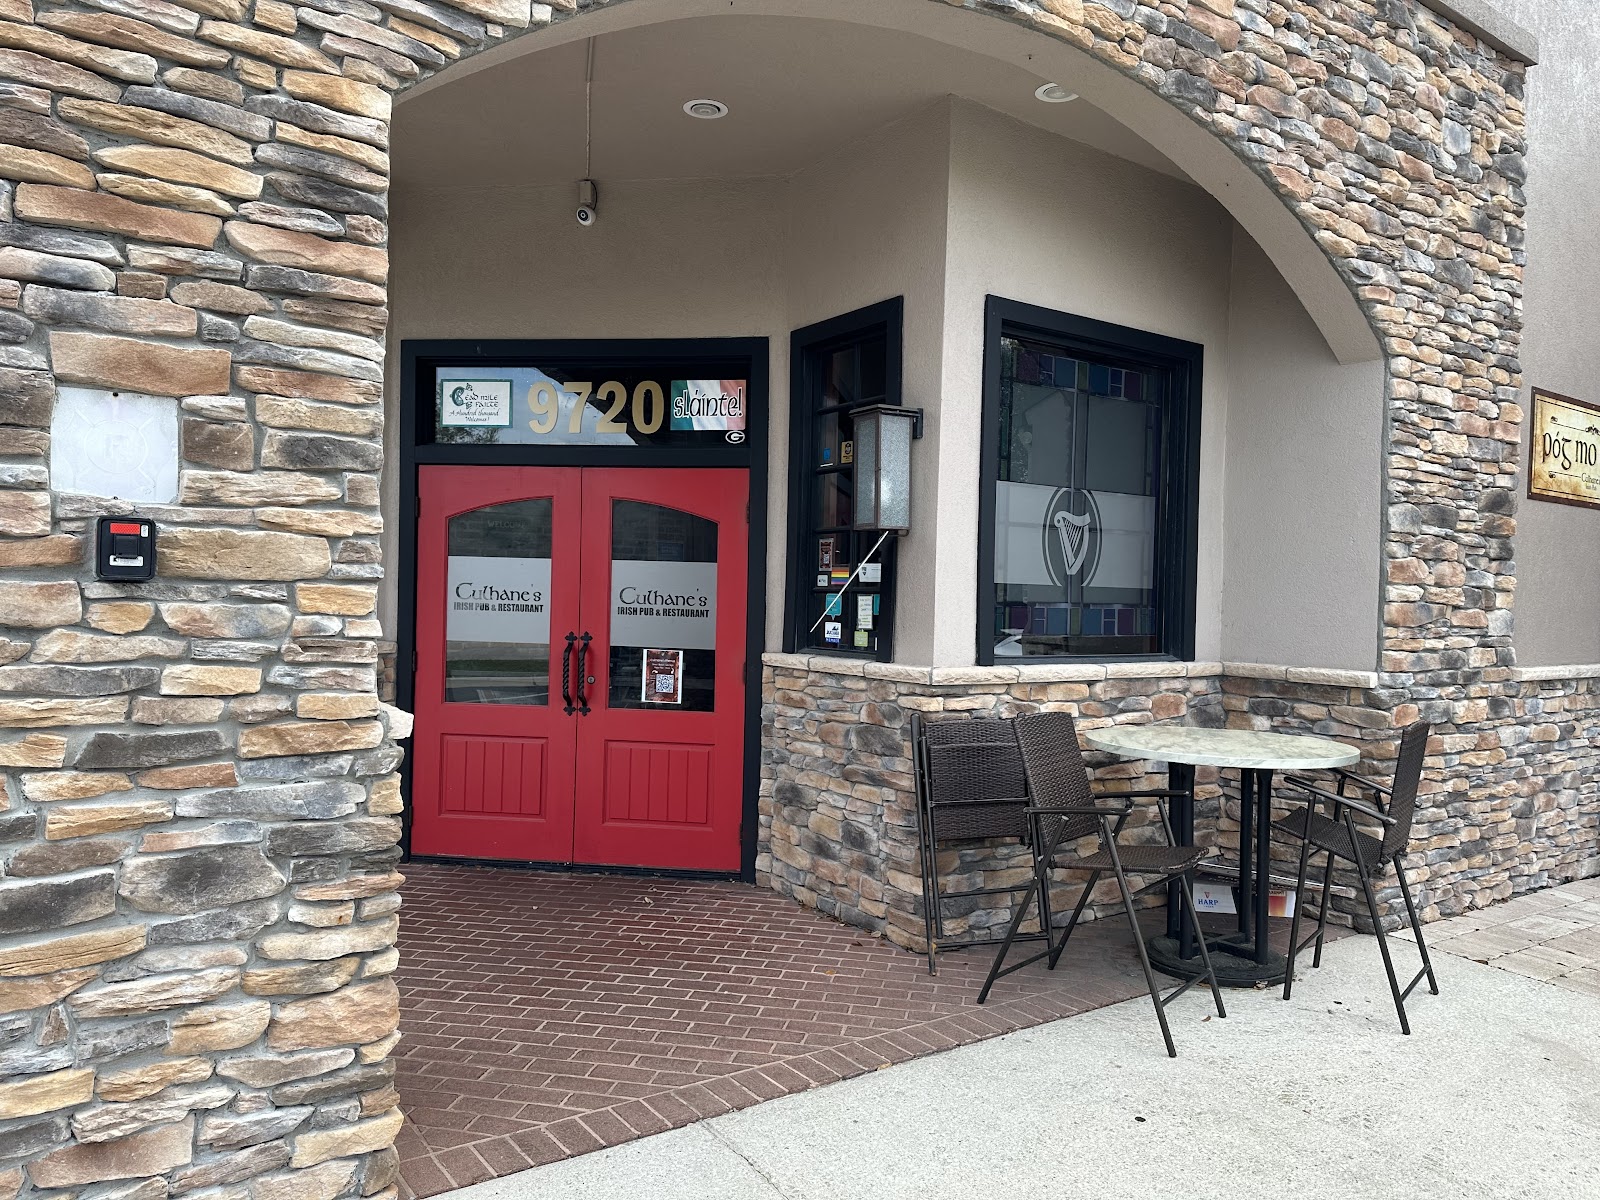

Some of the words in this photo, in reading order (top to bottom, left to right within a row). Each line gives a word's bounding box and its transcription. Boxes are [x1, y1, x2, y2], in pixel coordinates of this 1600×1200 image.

[527, 380, 664, 434] 9720
[1575, 440, 1597, 466] mo
[455, 582, 542, 602] Culhane's
[619, 586, 708, 607] Culhane's
[453, 602, 474, 611] IRISH
[475, 603, 490, 611] PUB
[491, 603, 497, 612] &
[498, 603, 544, 613] RESTAURANT
[617, 606, 638, 616] IRISH
[639, 607, 654, 616] PUB
[655, 608, 661, 617] &
[662, 608, 710, 618] RESTAURANT
